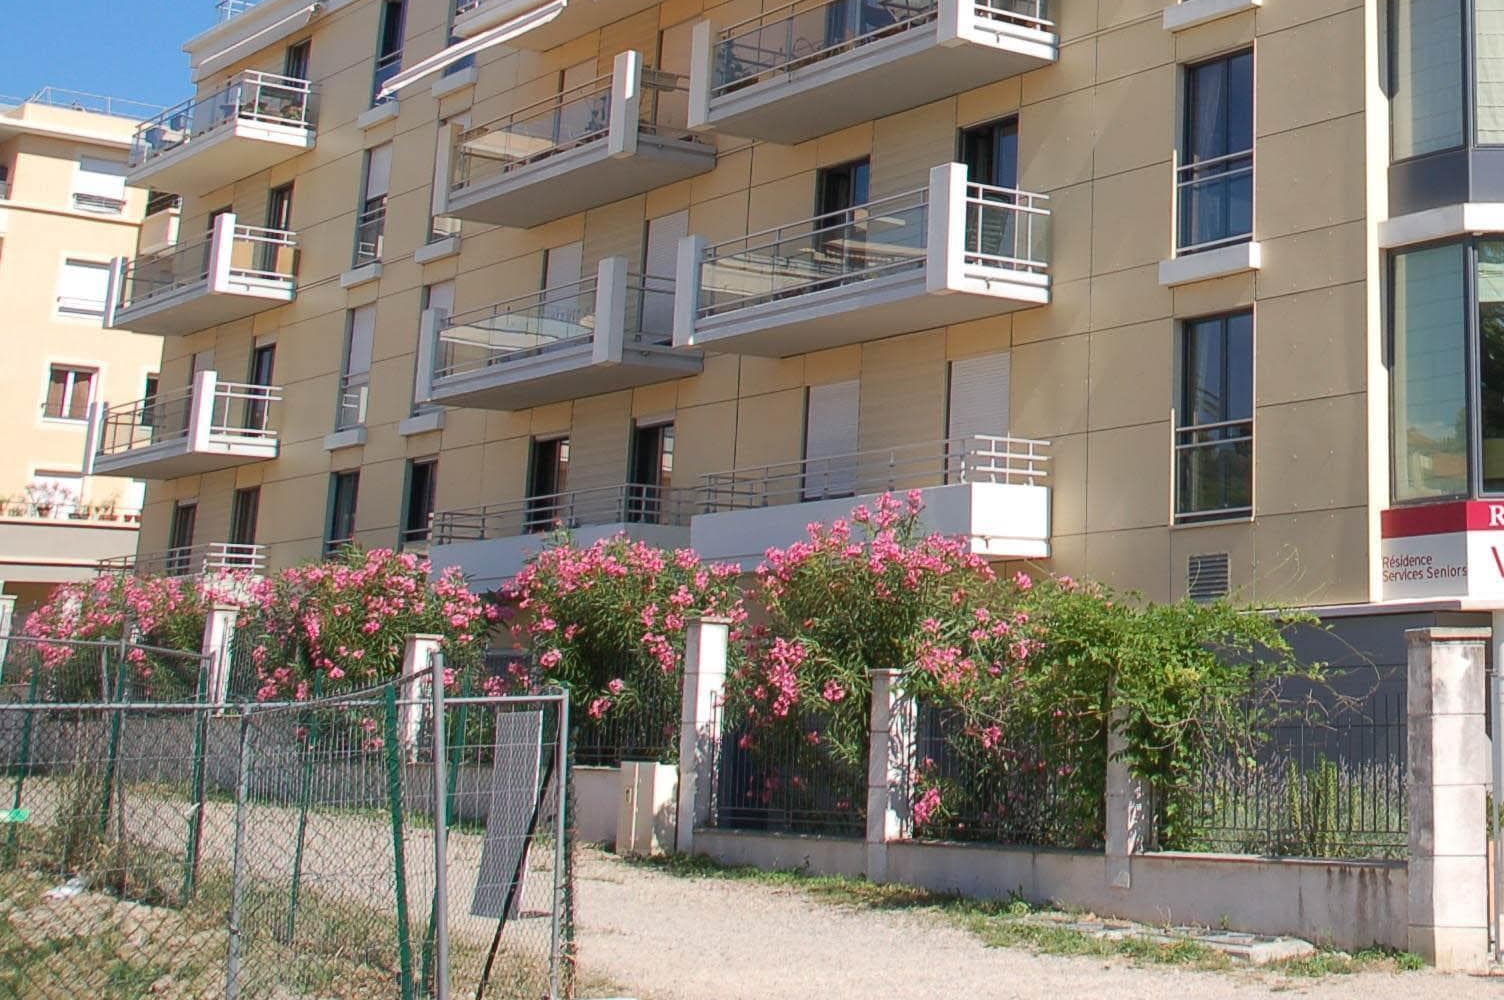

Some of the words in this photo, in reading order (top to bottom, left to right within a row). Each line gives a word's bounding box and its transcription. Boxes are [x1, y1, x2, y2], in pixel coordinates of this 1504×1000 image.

[1383, 554, 1433, 569] Résidence
[1383, 569, 1424, 582] Services
[1426, 565, 1468, 579] Seniors
